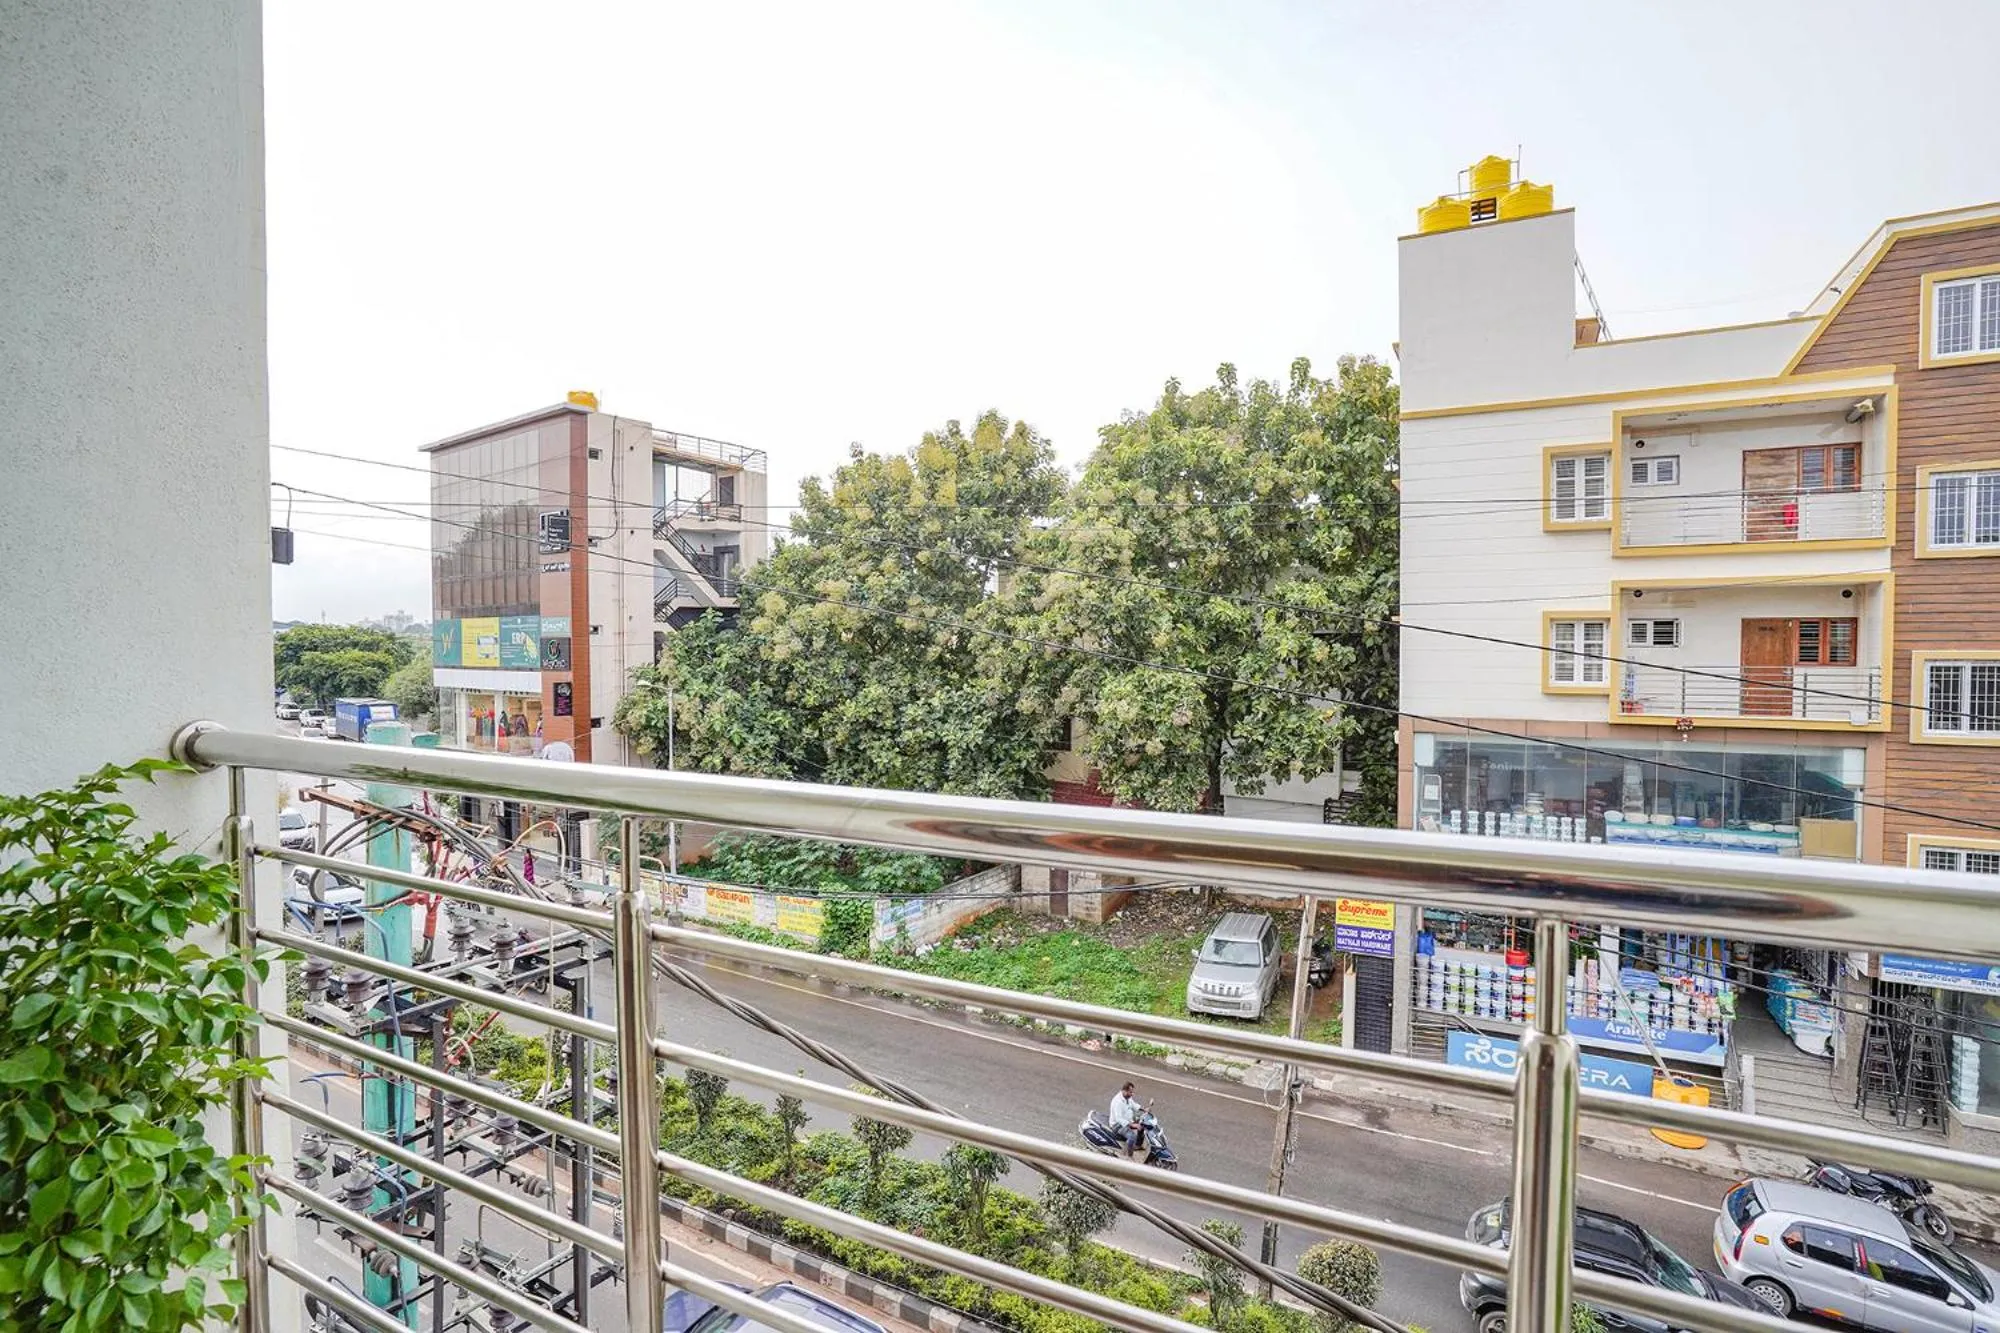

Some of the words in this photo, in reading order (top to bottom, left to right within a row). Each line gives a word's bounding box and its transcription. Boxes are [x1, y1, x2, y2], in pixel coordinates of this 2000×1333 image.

[1338, 899, 1388, 917] Supreme
[1360, 940, 1392, 951] HARDWARE
[1579, 1066, 1632, 1090] ERA
